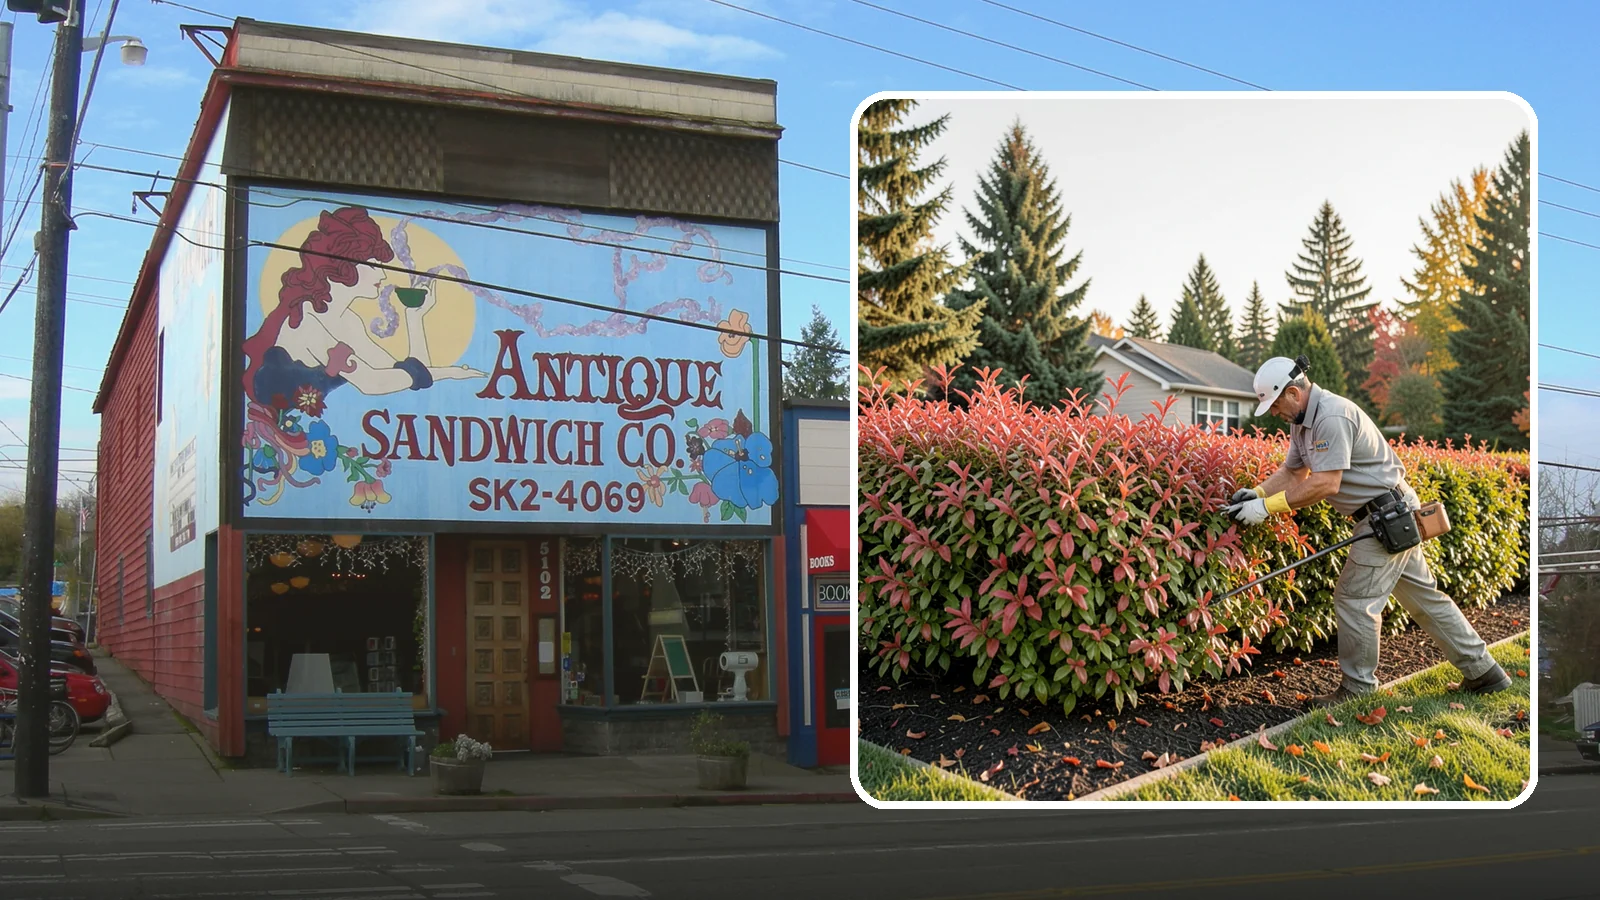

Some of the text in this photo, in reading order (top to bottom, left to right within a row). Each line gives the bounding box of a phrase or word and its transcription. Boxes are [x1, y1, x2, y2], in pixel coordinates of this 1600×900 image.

[476, 329, 723, 420] ANTIQUE
[361, 409, 685, 469] SANDWICH CO.
[468, 477, 646, 513] SK2-4069
[540, 541, 551, 600] 5102
[809, 555, 835, 569] BOOKS
